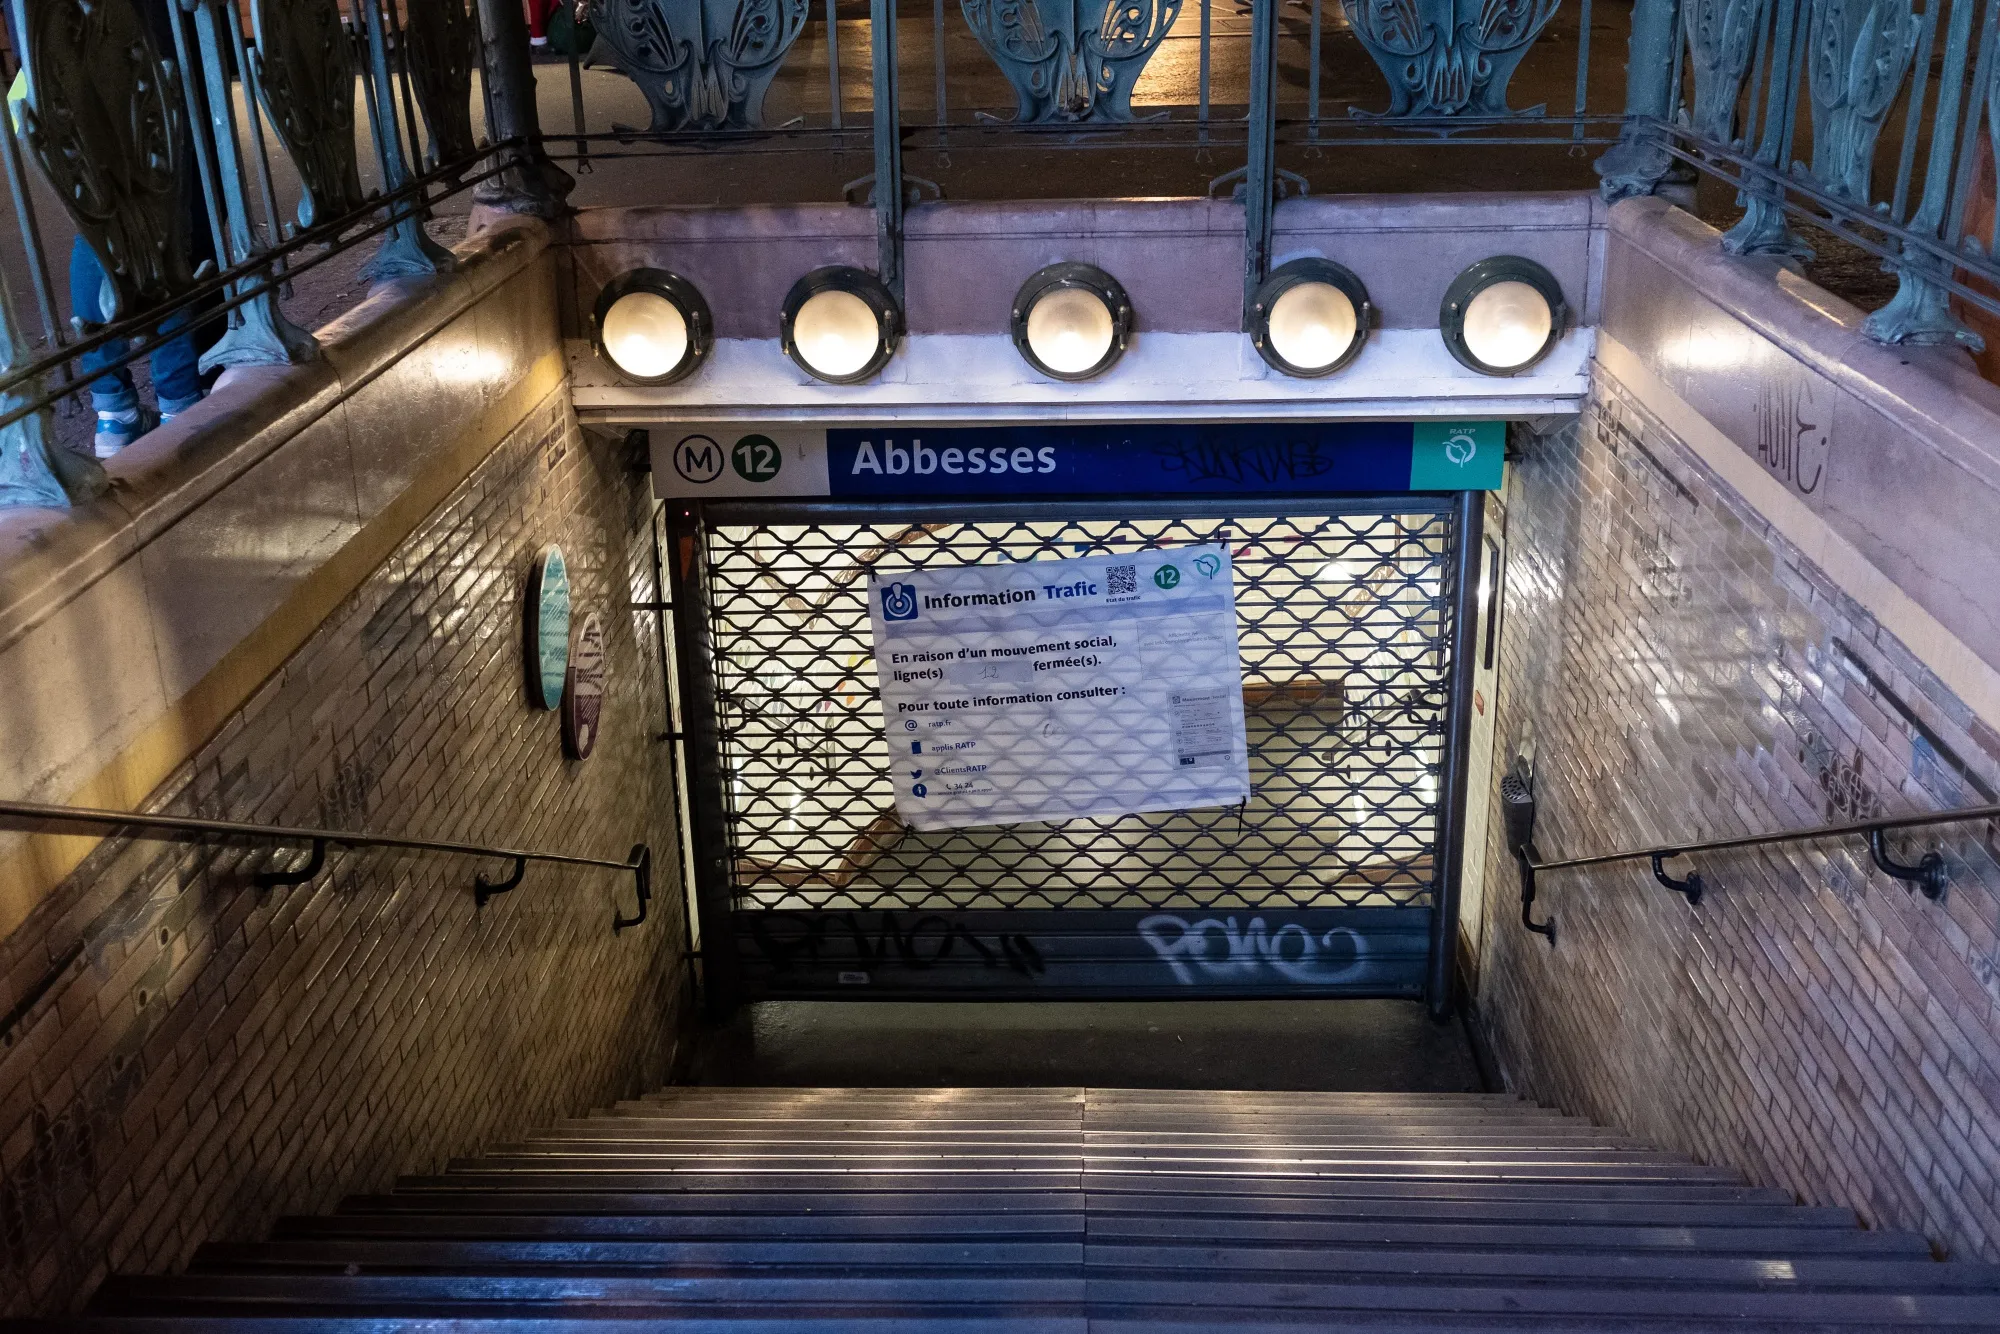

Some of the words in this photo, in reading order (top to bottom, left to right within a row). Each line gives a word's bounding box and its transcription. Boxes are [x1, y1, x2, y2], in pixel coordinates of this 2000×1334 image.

[685, 446, 713, 473] M
[736, 444, 776, 473] 12
[851, 439, 1057, 475] Abbesses
[1156, 569, 1177, 585] 12
[924, 588, 1036, 610] Information
[1043, 581, 1098, 600] Trafic
[892, 653, 909, 664] En
[912, 650, 954, 663] raison
[957, 648, 987, 659] d'un
[991, 641, 1071, 657] mouvement
[1074, 635, 1117, 650] social,
[893, 667, 944, 682] ligne(s)
[1033, 654, 1102, 672] fermée(s).
[898, 702, 930, 713] Pour
[934, 699, 969, 711] toute
[973, 693, 1053, 707] information
[1056, 687, 1119, 700] consulter
[928, 719, 952, 728] ratp.fr
[931, 743, 954, 753] applis
[955, 741, 976, 750] RATP
[934, 764, 987, 775] @ClientsRATP
